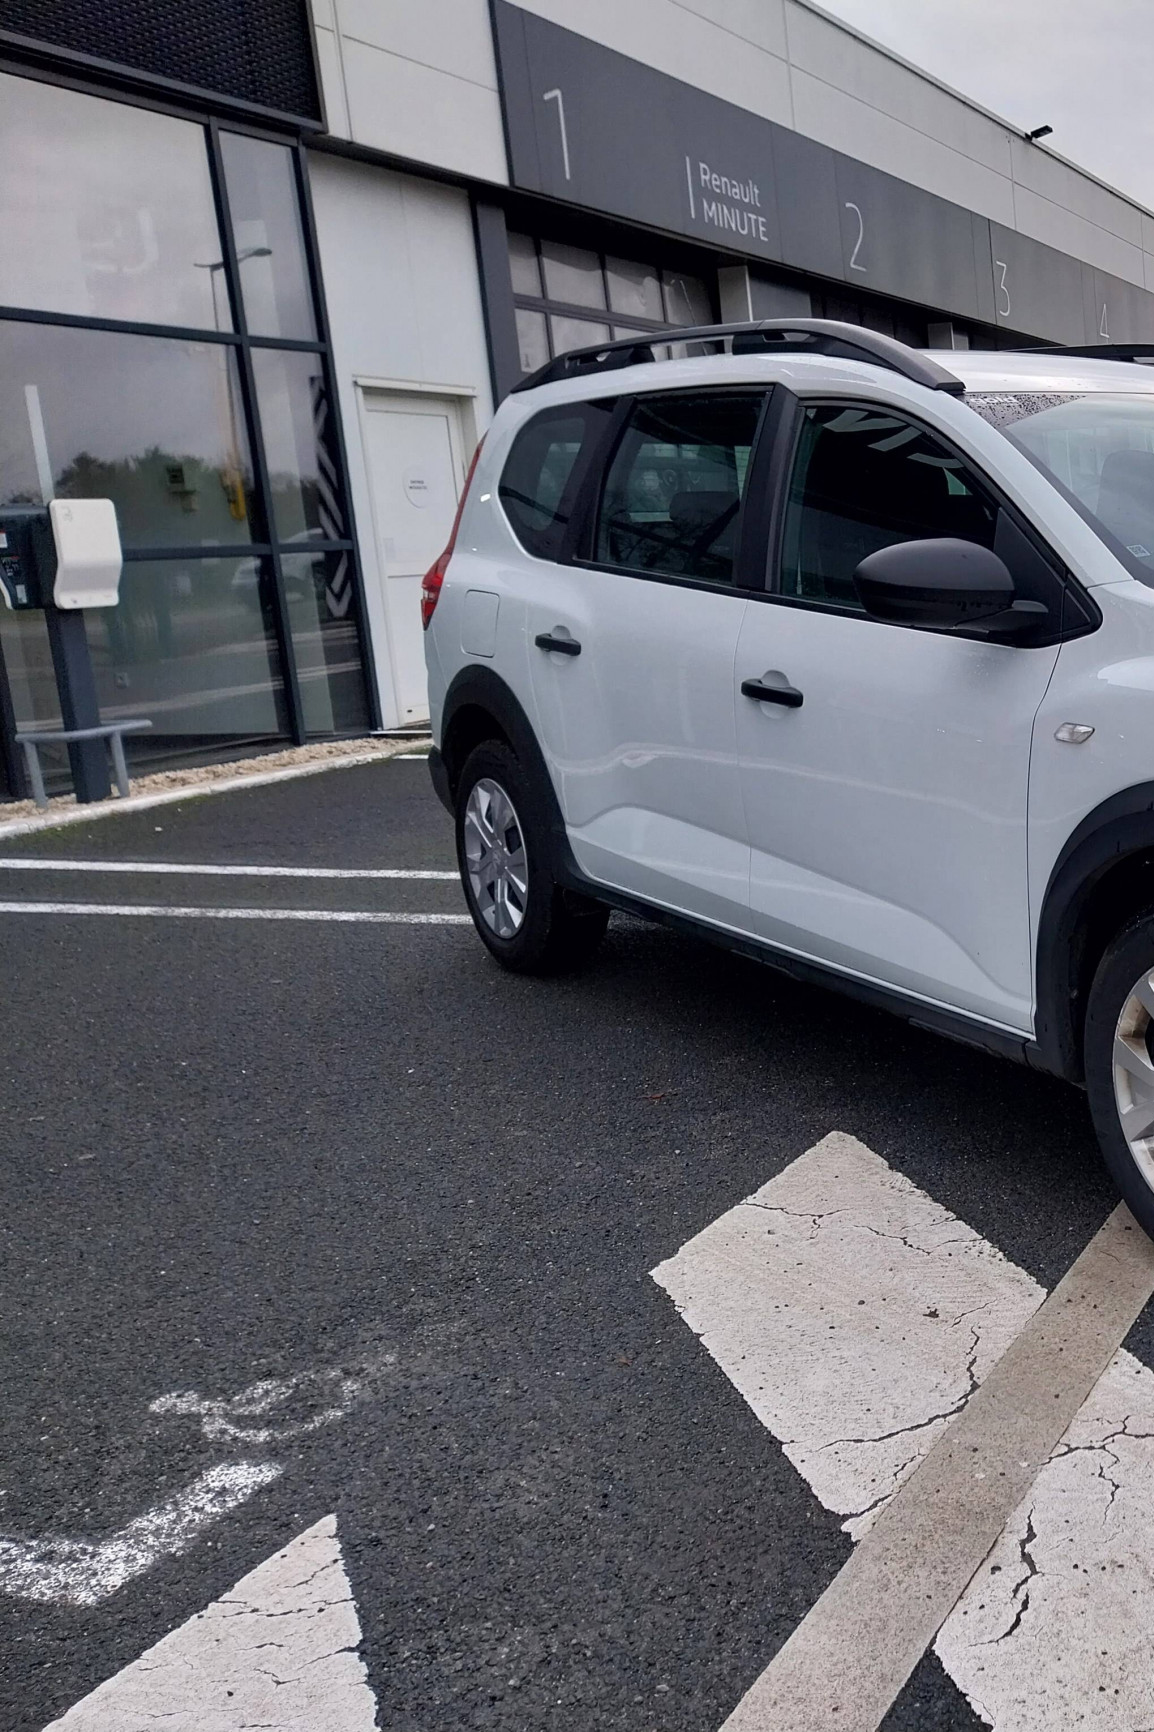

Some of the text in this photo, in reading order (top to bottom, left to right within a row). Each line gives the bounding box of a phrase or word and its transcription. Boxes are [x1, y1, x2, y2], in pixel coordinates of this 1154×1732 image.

[543, 88, 571, 180] 1
[699, 161, 761, 207] Renault
[703, 198, 769, 241] MINUTE
[845, 202, 867, 272] 2
[996, 261, 1011, 316] 3
[1100, 303, 1110, 344] 4
